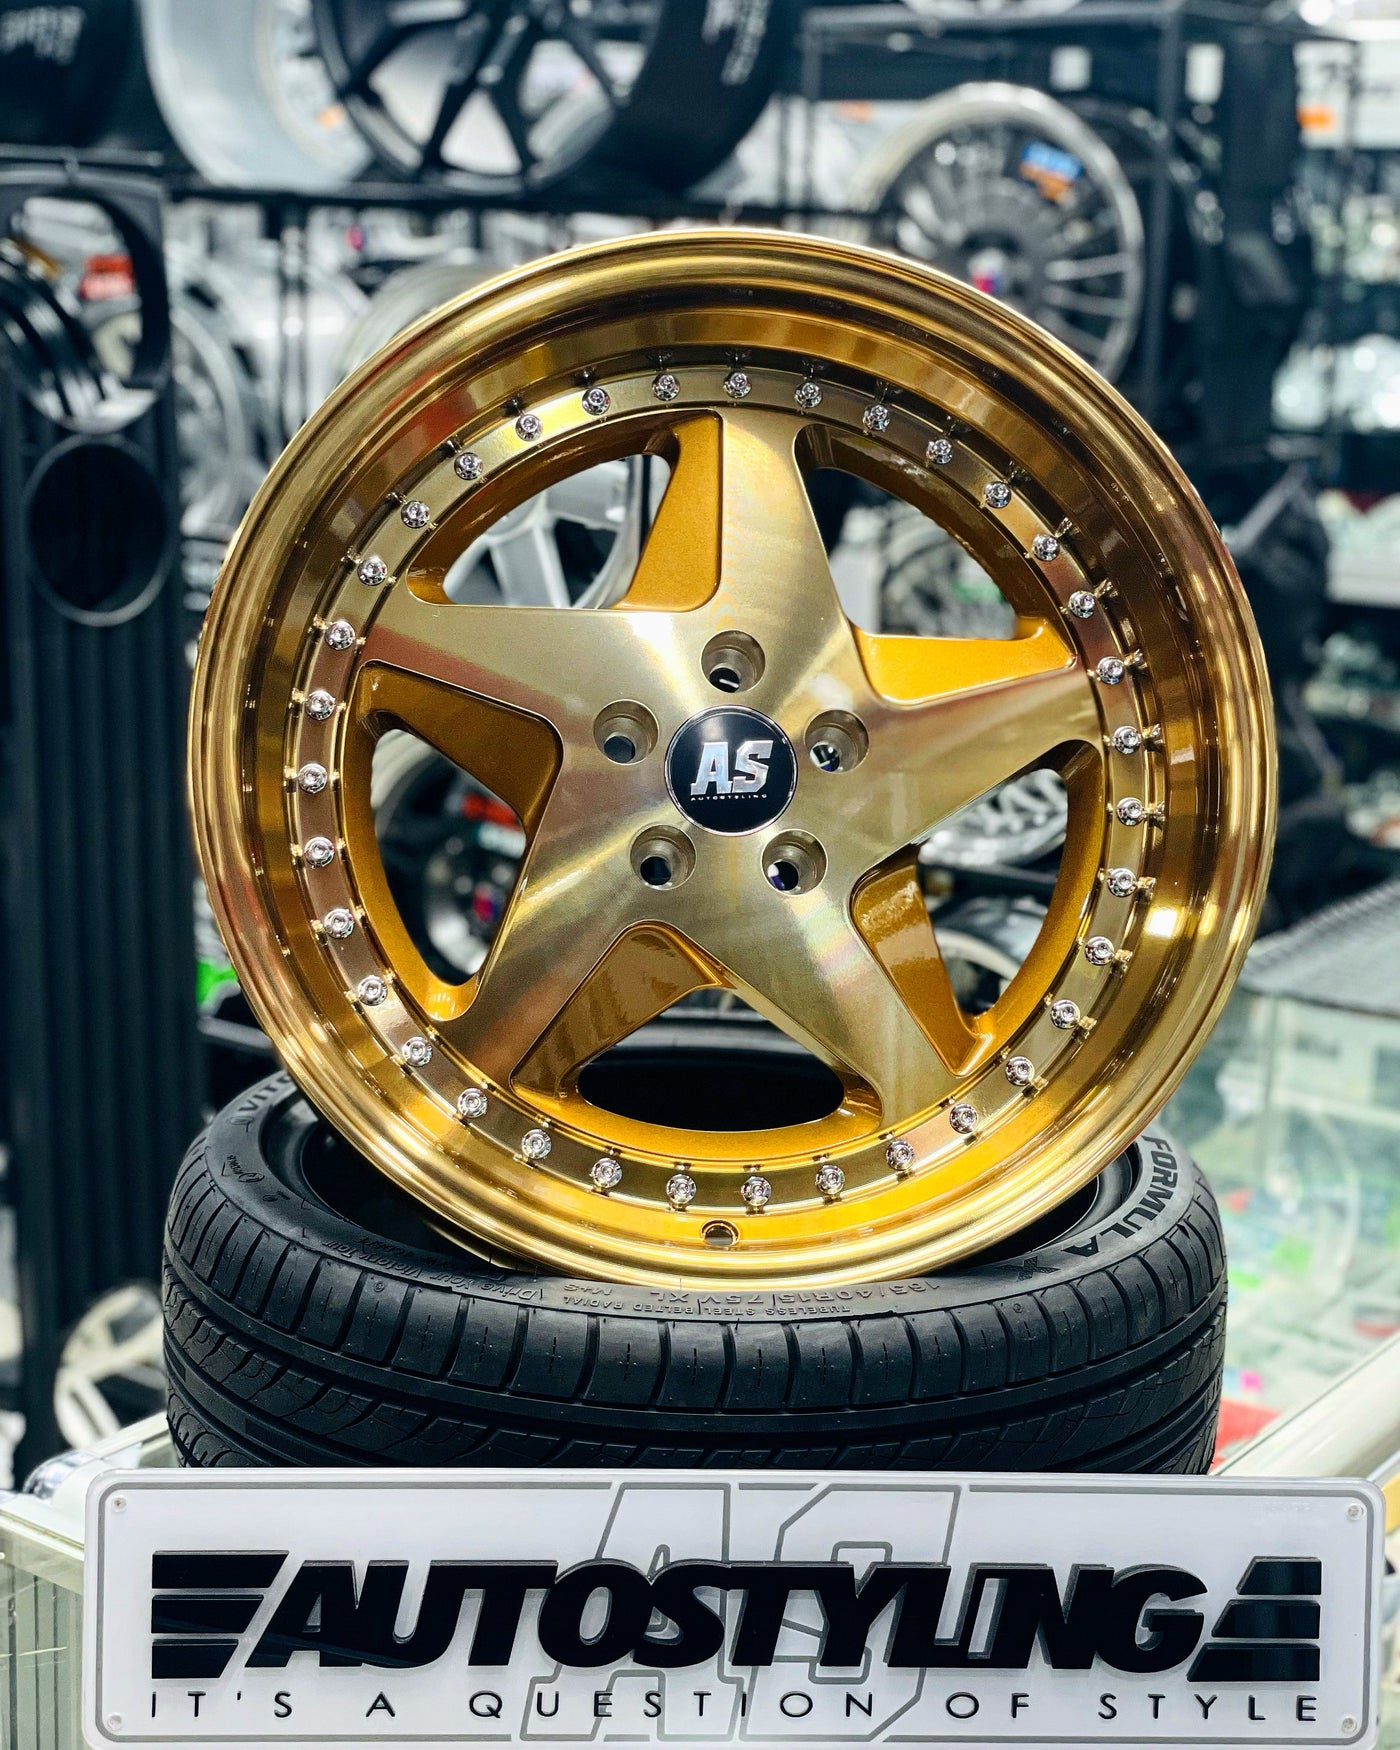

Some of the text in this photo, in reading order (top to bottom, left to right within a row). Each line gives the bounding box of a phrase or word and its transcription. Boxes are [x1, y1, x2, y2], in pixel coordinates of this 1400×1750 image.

[690, 740, 774, 795] AS
[690, 793, 768, 802] AUTOSTYLING
[1063, 1135, 1178, 1258] FORMULA
[321, 1239, 358, 1258] Tour
[357, 1253, 424, 1279] Victory
[430, 1272, 475, 1291] Your
[479, 1282, 539, 1301] Drive
[562, 1295, 850, 1316] TUBELESS STEEL BELTED RADIAL
[244, 1558, 1208, 1673] AUTOSTYLING
[150, 1690, 1319, 1722] IT'S A QUESTION OF STYLE
